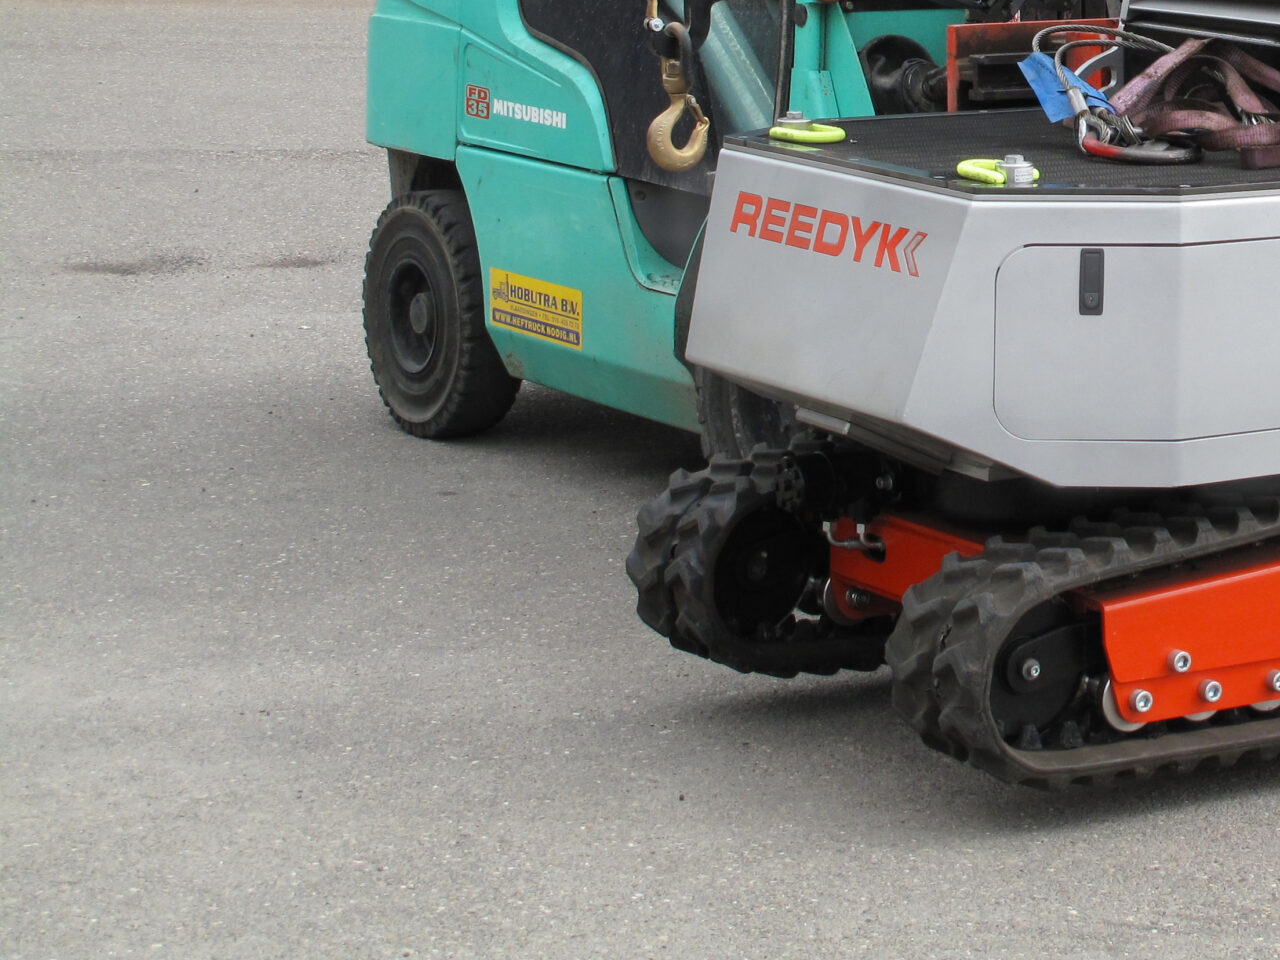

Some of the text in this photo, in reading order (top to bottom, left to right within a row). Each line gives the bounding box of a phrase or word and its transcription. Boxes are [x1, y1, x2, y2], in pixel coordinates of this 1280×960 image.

[467, 86, 488, 100] FD
[467, 100, 488, 117] 35
[493, 98, 567, 129] MITSUBISHI
[730, 191, 910, 273] REEDYK
[510, 284, 580, 316] HOBUTRA B.V.
